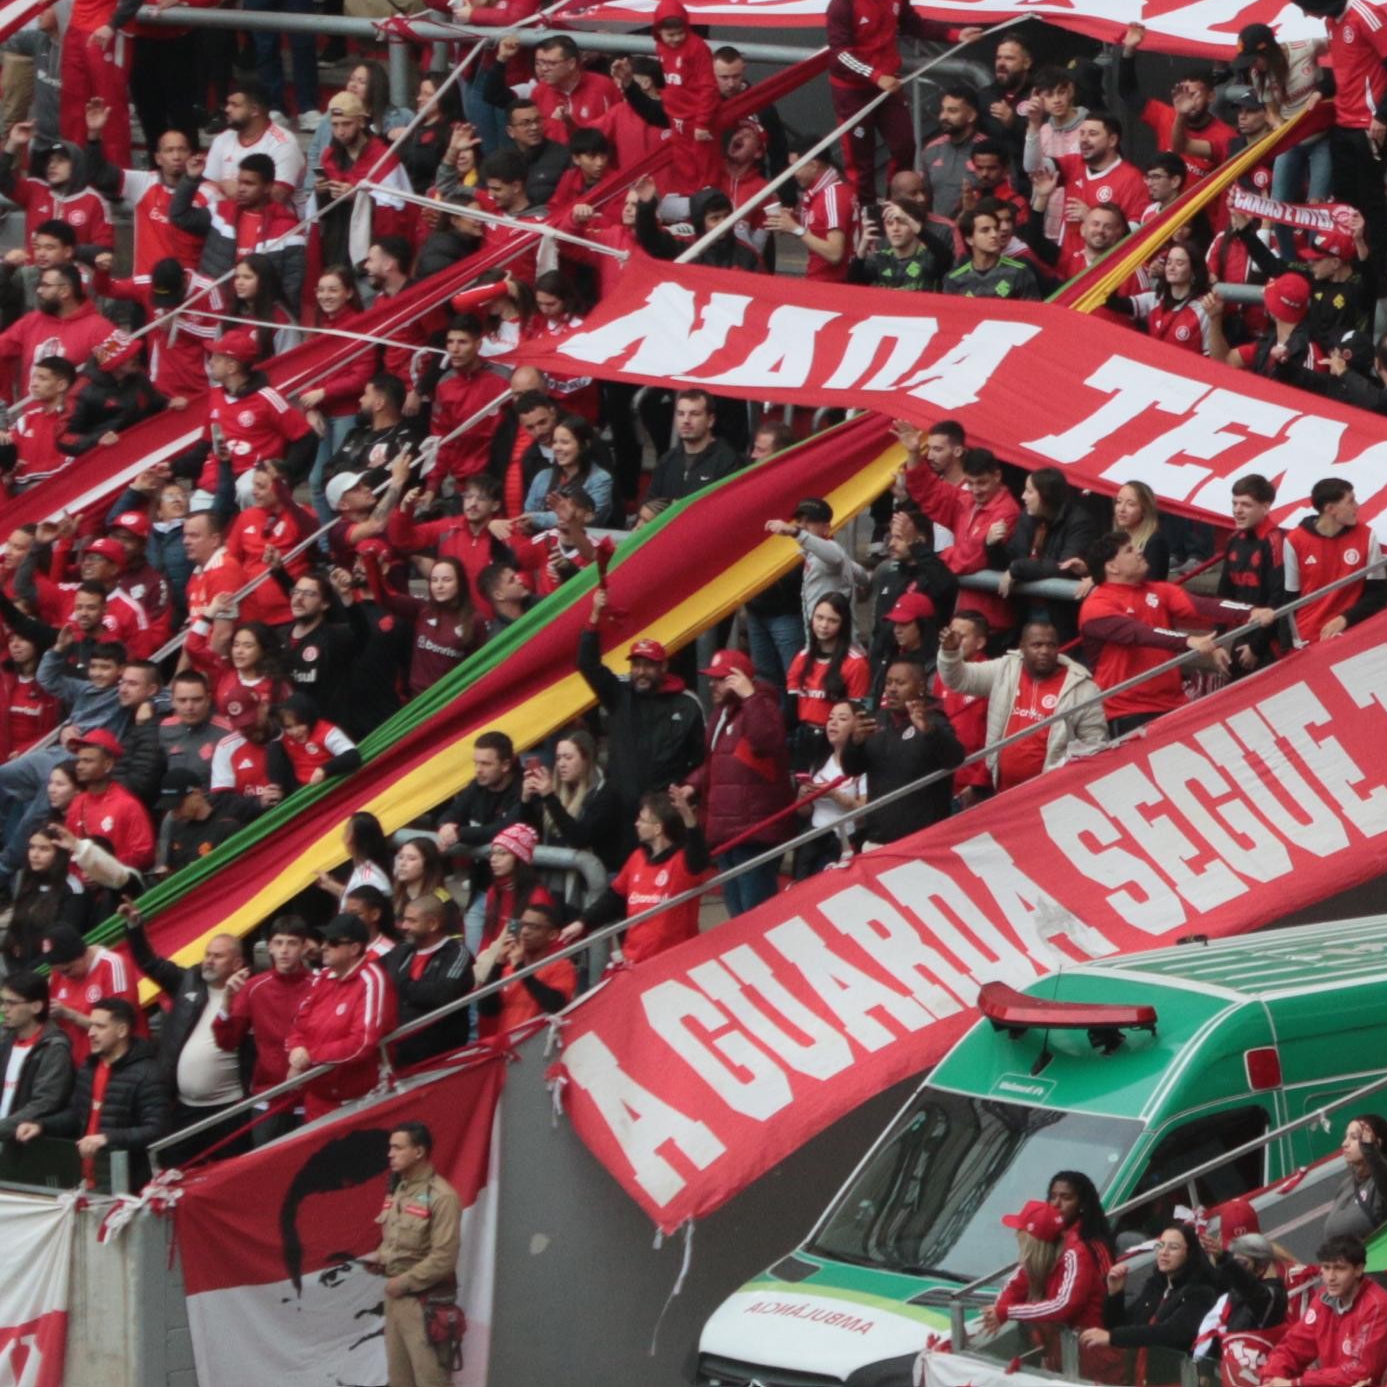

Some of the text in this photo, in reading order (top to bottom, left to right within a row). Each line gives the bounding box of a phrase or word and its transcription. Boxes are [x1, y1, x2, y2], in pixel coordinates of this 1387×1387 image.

[552, 279, 1045, 409] NADA
[638, 831, 1123, 1124] GUARDA
[557, 1031, 729, 1207] A
